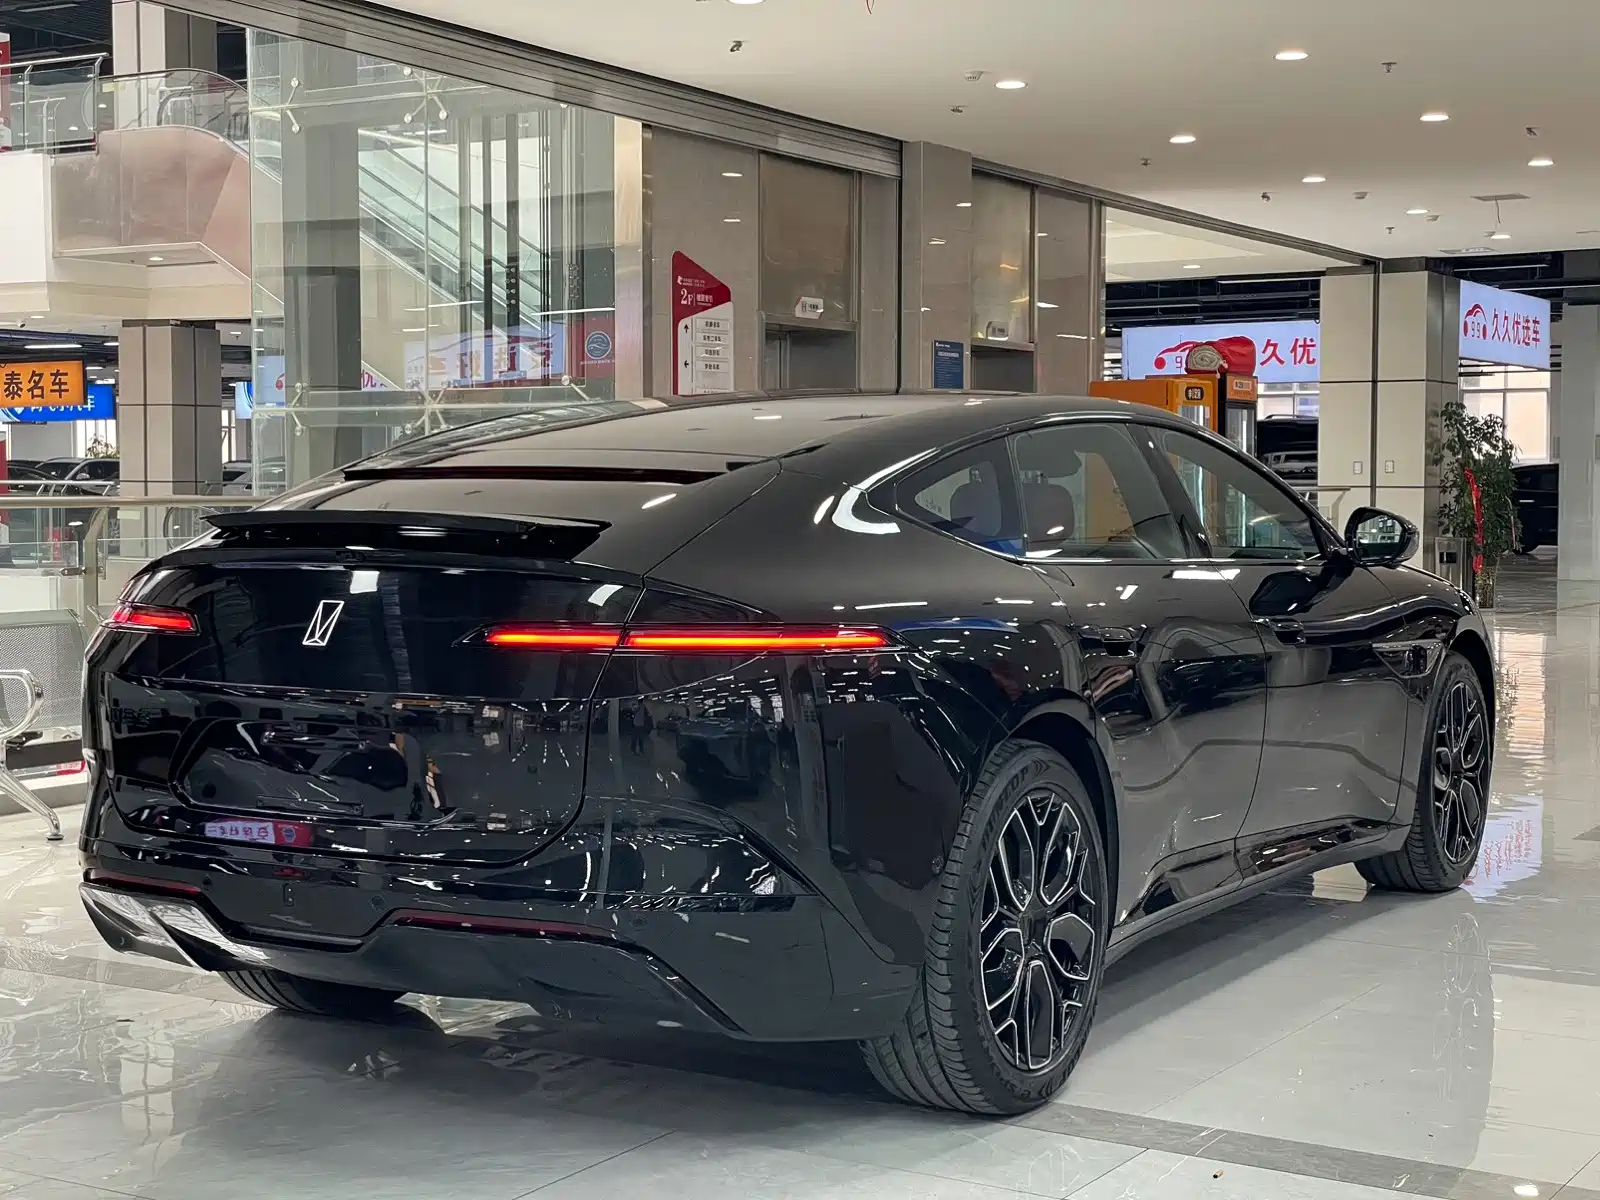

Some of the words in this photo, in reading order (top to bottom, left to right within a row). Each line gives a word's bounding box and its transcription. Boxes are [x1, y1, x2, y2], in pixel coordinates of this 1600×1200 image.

[680, 288, 694, 305] 2F
[1491, 307, 1541, 350] 久久优选车
[3, 369, 69, 400] 泰名车
